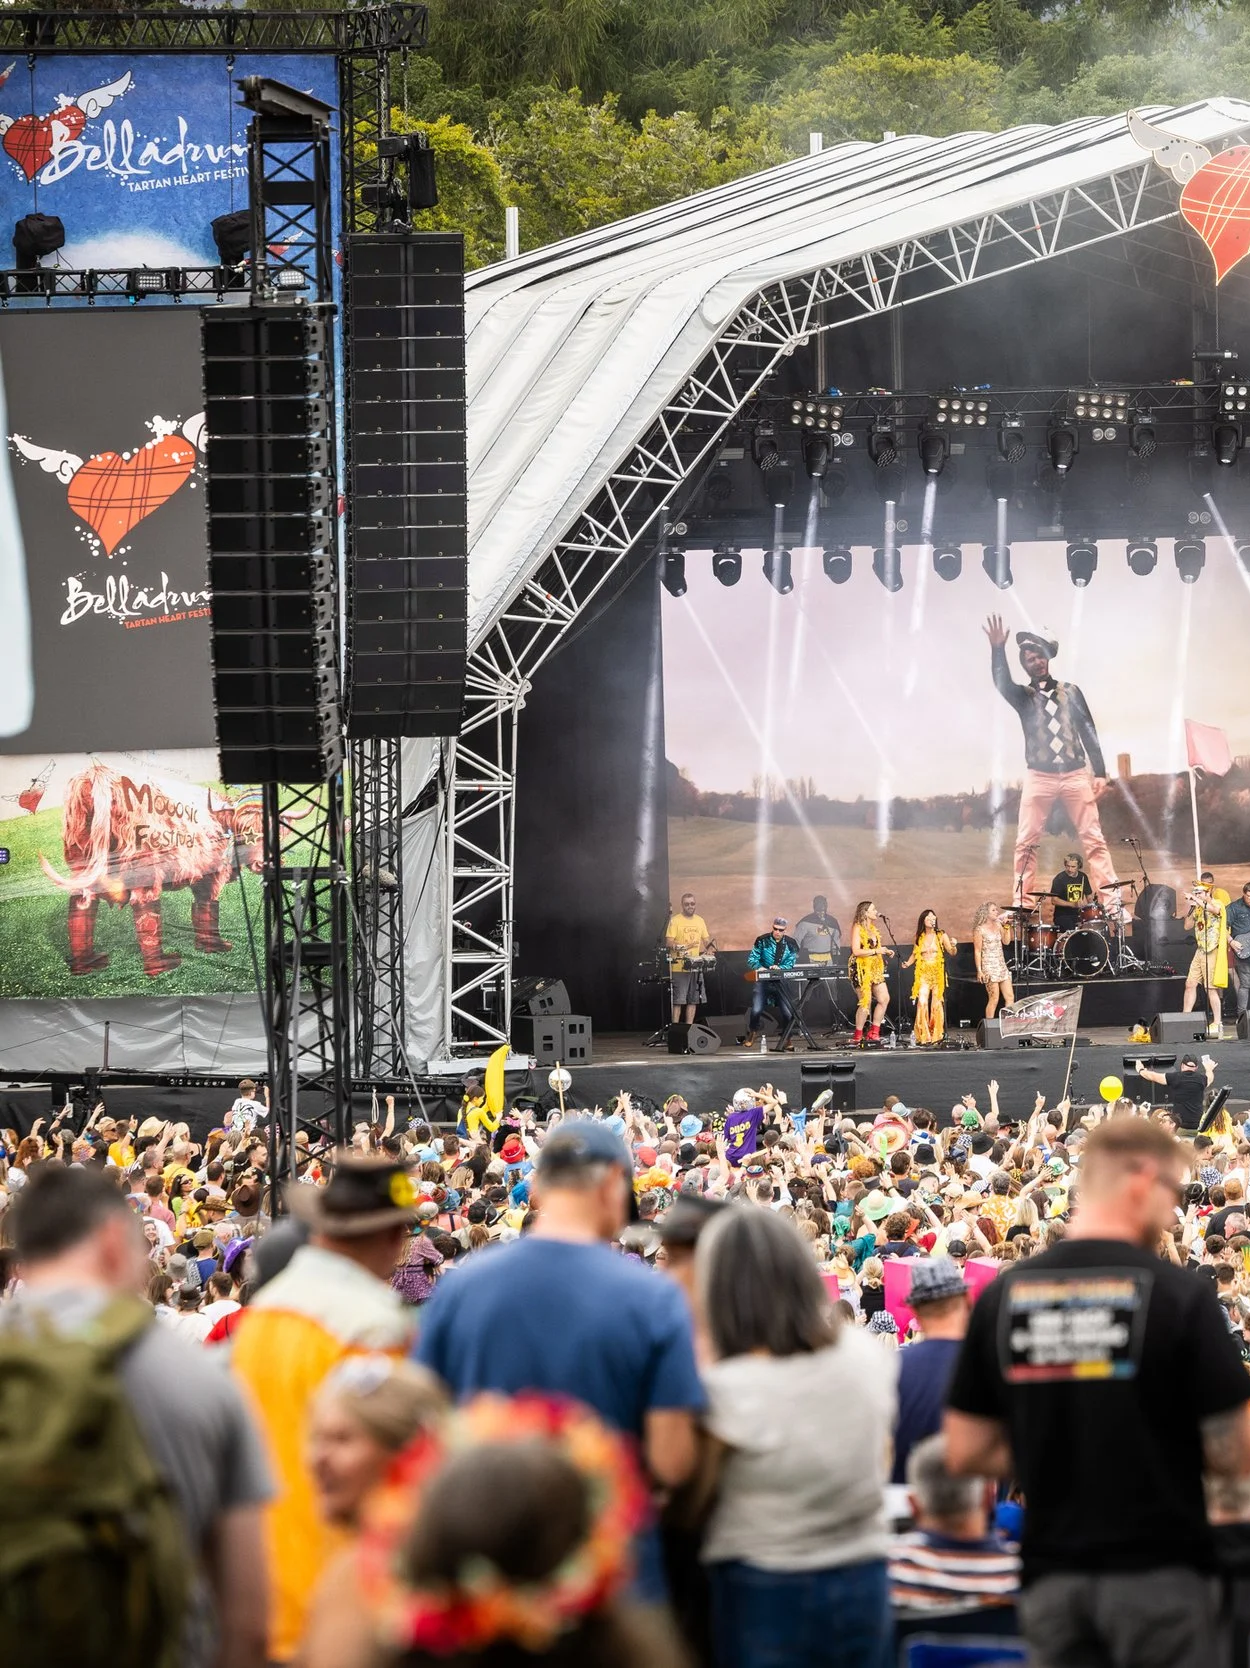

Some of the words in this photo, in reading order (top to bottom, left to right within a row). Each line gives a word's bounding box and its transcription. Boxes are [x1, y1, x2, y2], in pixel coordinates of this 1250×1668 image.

[127, 177, 171, 192] TARTAN
[173, 171, 211, 186] HEART
[214, 166, 250, 180] FESTIV
[124, 617, 157, 629] TARTAN
[158, 611, 186, 623] HEART
[188, 607, 213, 619] FESTI
[135, 824, 195, 850] Festival
